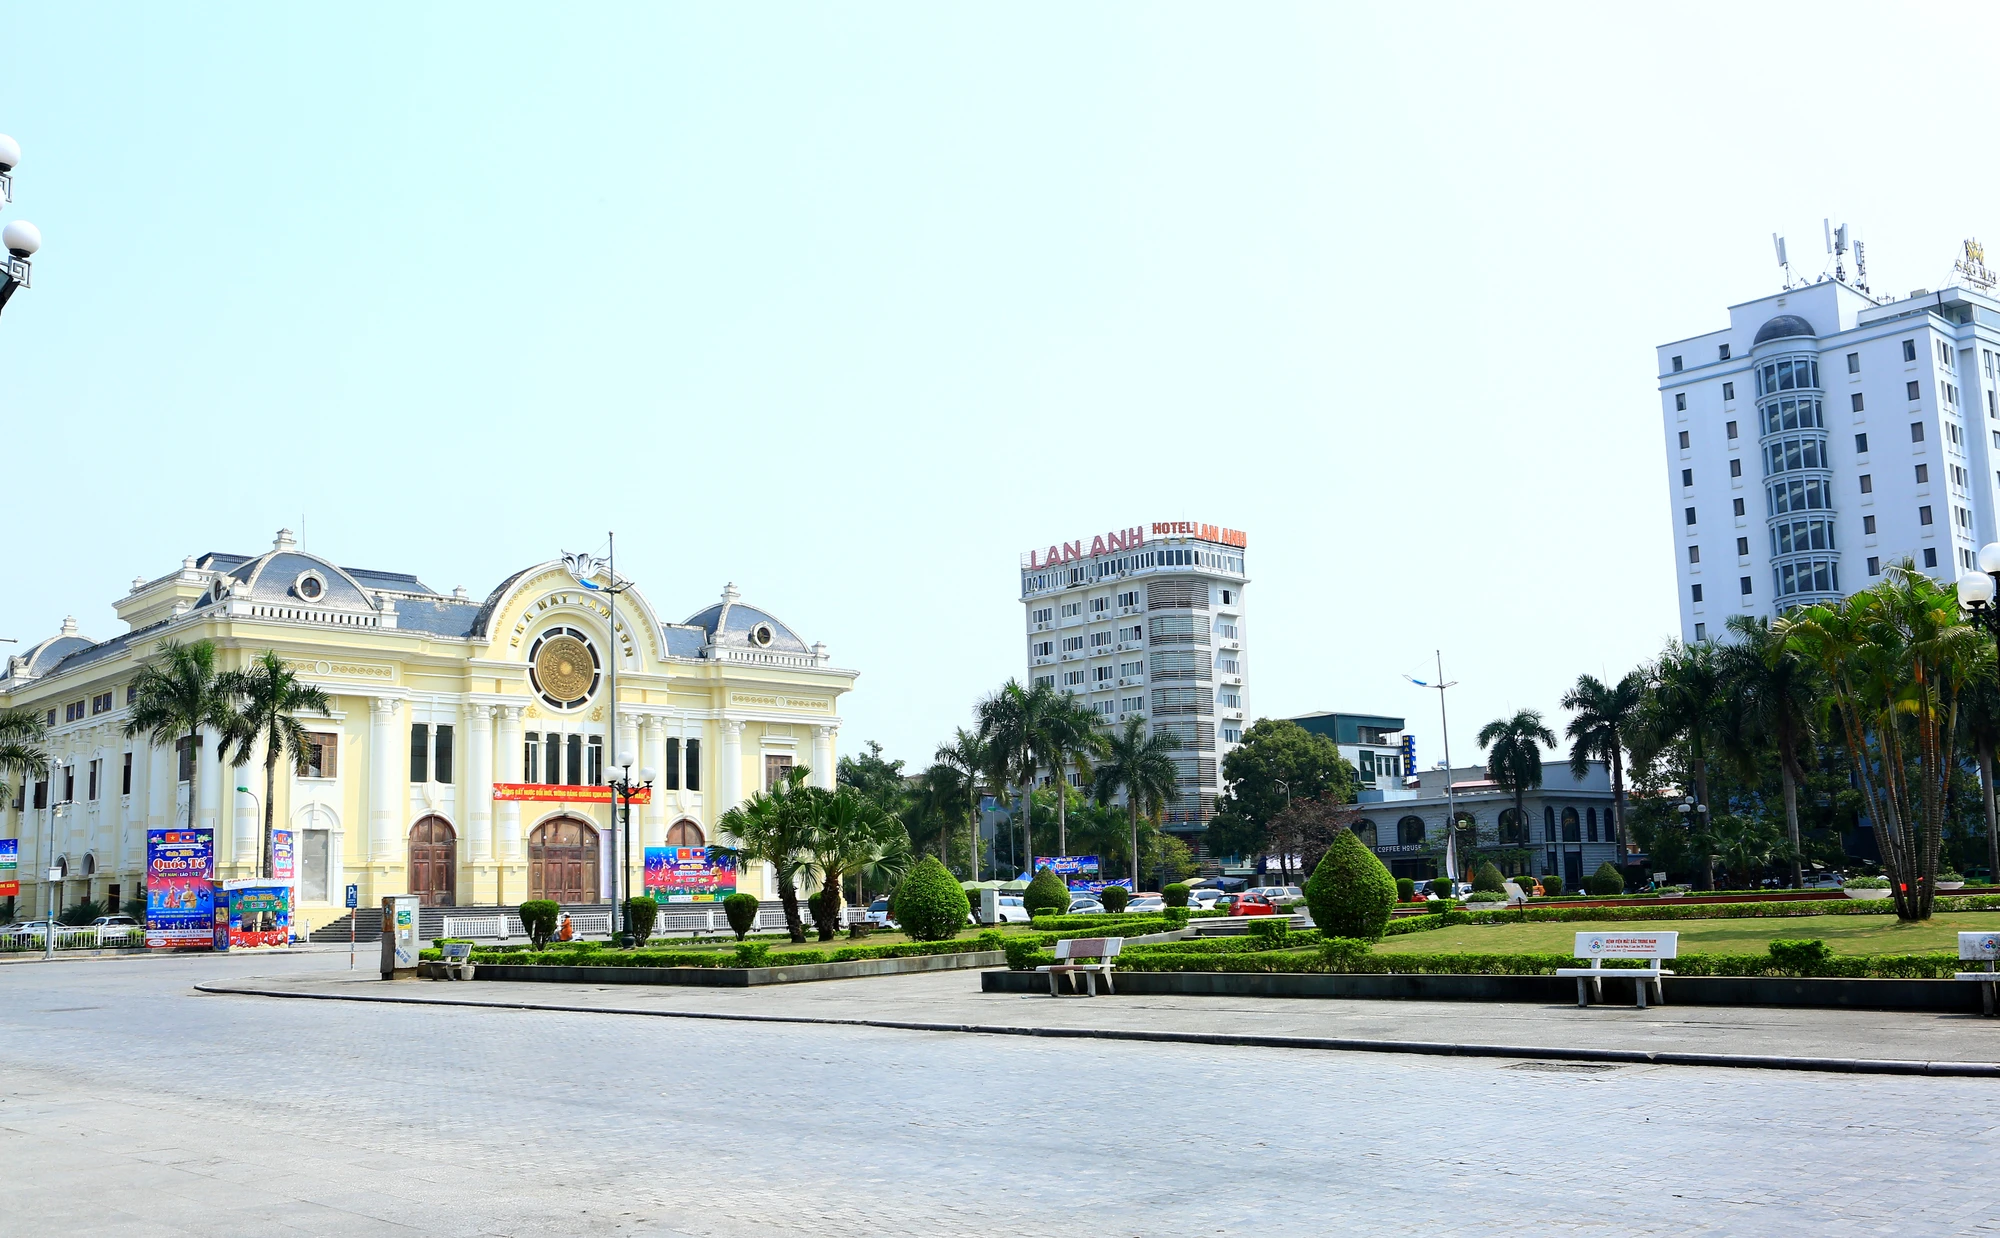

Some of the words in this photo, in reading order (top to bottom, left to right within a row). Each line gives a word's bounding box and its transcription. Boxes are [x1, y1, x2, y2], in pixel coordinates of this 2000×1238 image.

[1152, 522, 1194, 534] HOTEL
[1194, 522, 1219, 542] LAN
[1222, 528, 1247, 548] ANH
[1031, 540, 1081, 570] LAN
[1089, 526, 1144, 558] ANH
[578, 595, 611, 619] LAM
[1377, 845, 1400, 853] COFFEE
[1402, 844, 1422, 852] HOUSE
[153, 857, 187, 872] Quốc
[188, 856, 207, 869] Tế
[348, 886, 355, 899] P
